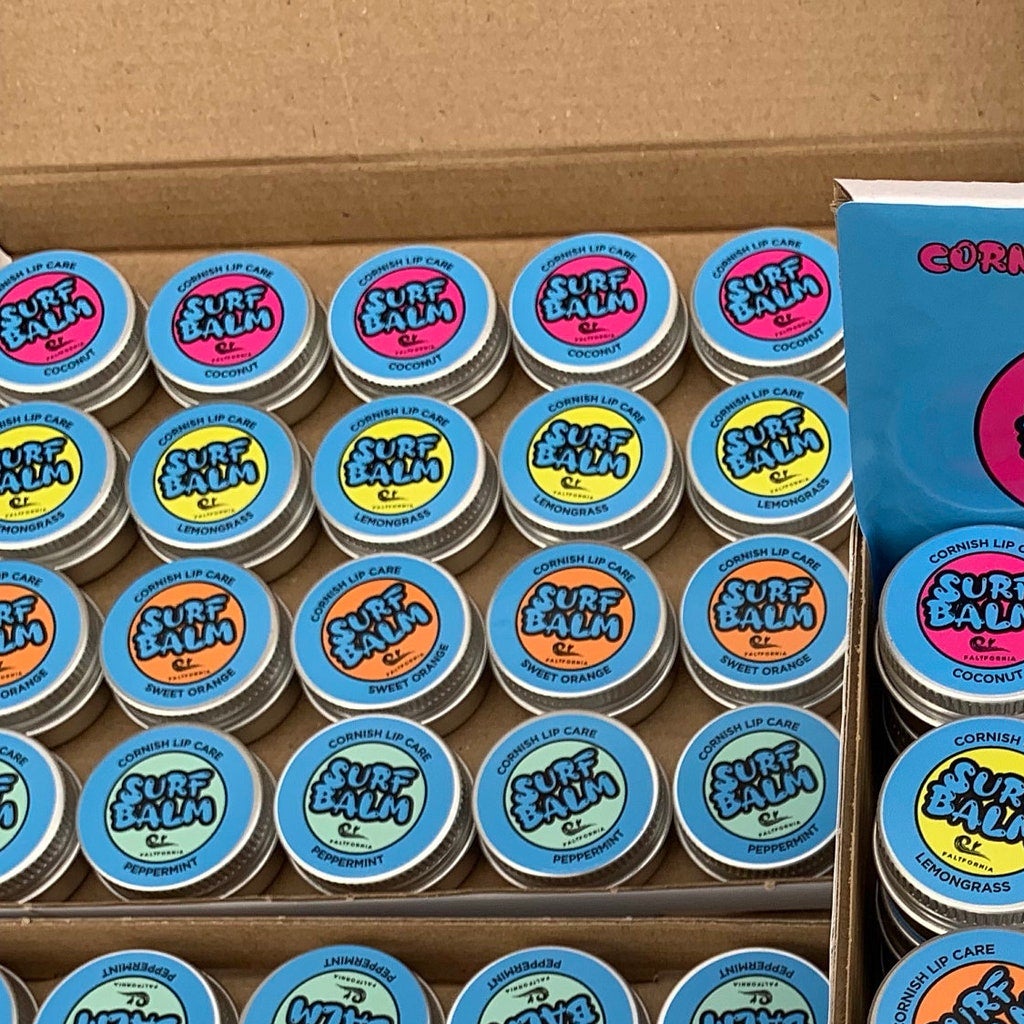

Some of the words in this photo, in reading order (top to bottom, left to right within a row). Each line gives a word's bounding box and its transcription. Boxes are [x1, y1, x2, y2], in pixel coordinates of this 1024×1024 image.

[181, 284, 266, 322] SURF
[177, 307, 275, 342] BALM
[202, 360, 260, 377] COCONUT
[546, 394, 598, 412] CORNISH
[601, 395, 619, 406] LIP
[618, 401, 645, 424] CARE
[542, 419, 633, 451] SURF
[533, 440, 629, 478] BALM
[532, 494, 608, 515] LEMONGRASS
[927, 538, 987, 563] CORNISH
[992, 538, 1014, 549] LIP
[132, 570, 181, 603] CORNISH
[185, 568, 202, 577] LIP
[204, 569, 236, 586] CARE
[138, 593, 229, 636] SURF
[133, 618, 236, 660] BALM
[142, 683, 183, 697] SWEET
[187, 667, 235, 696] ORANGE
[950, 667, 1024, 682] COCONUT
[326, 728, 382, 749] CORNISH
[385, 729, 404, 741] LIP
[403, 736, 432, 762] CARE
[952, 731, 1022, 747] CORNISH
[320, 757, 418, 793] SURF
[310, 782, 412, 824] BALM
[309, 845, 384, 867] PEPPERMINT
[940, 851, 994, 873] FALTFORNIA
[914, 852, 1011, 892] LEMONGRASS
[100, 962, 176, 981] PEPPERMINT
[925, 953, 950, 973] LIP
[950, 944, 995, 960] CARE
